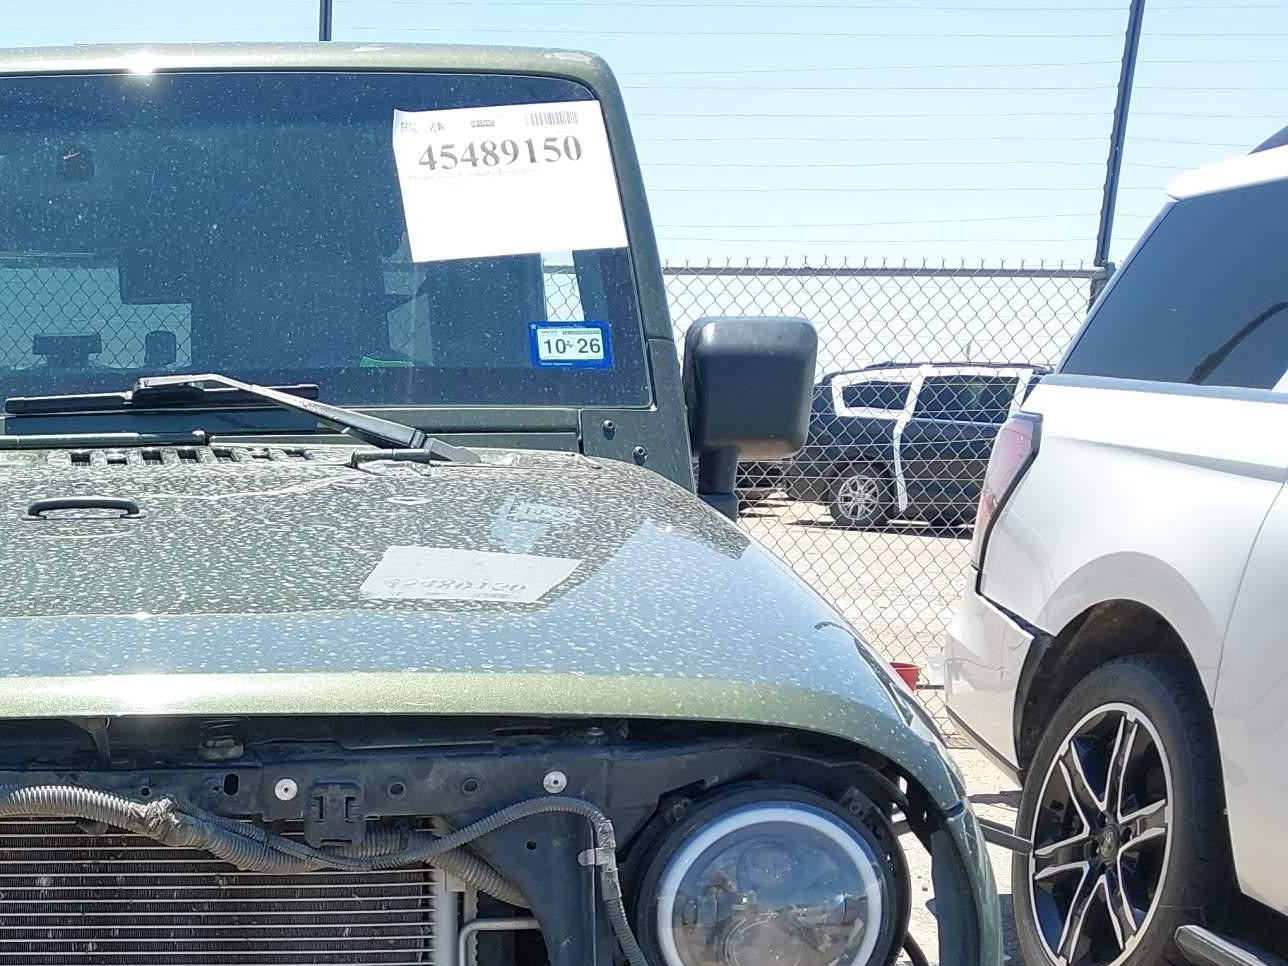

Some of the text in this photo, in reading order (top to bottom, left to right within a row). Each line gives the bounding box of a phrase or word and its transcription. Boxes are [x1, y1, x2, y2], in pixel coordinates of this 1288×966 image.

[418, 134, 583, 171] 45489150
[543, 338, 601, 354] 10 26
